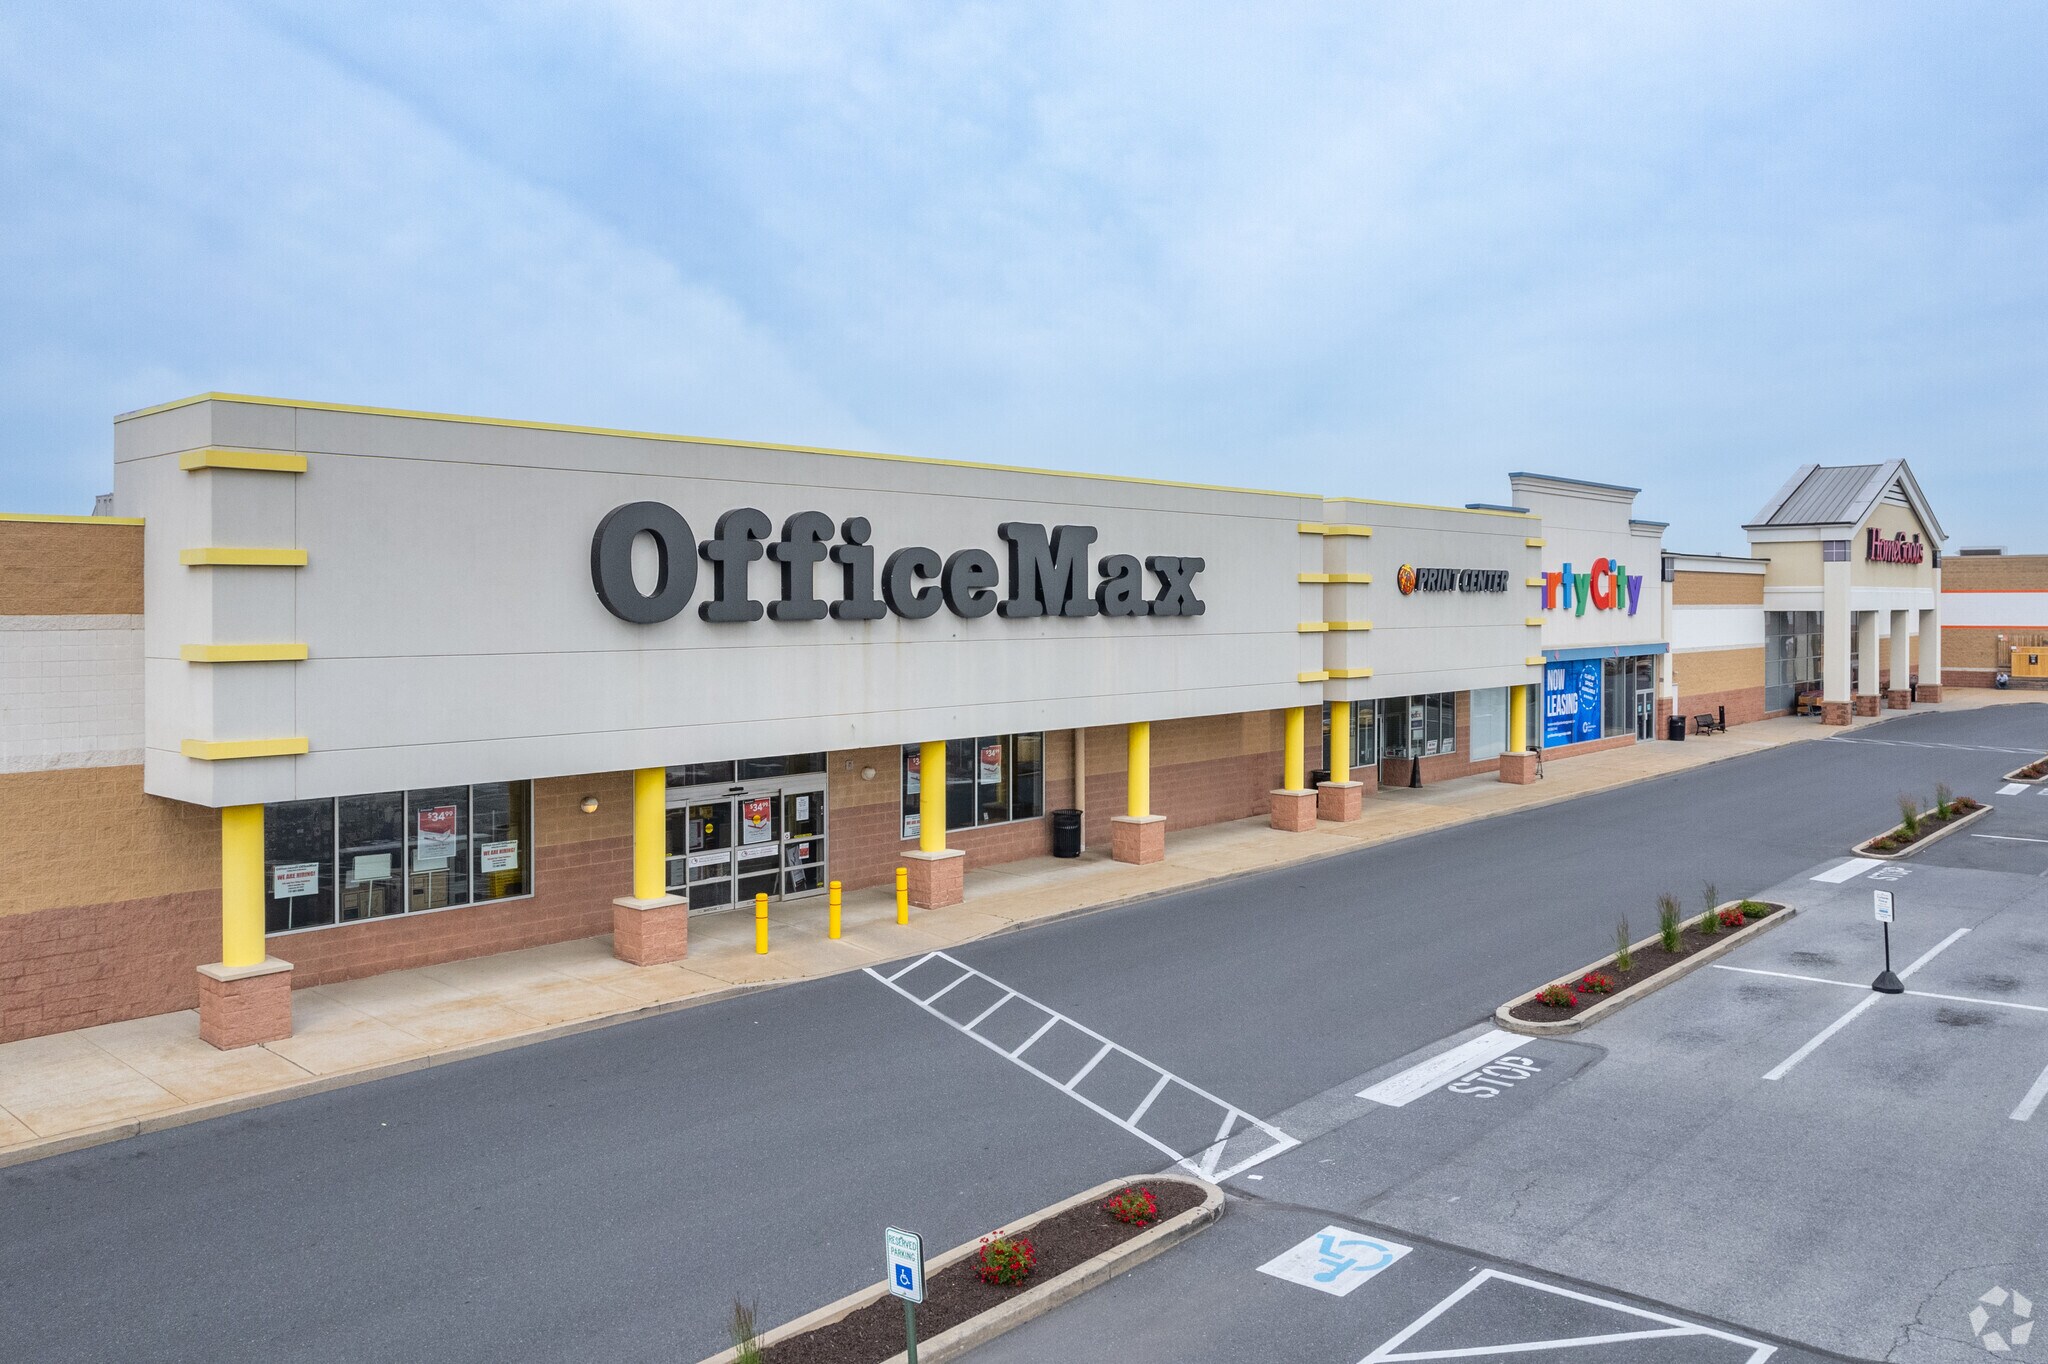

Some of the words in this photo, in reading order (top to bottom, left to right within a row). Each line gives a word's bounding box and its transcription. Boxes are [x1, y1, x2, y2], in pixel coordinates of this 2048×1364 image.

[1867, 528, 1923, 564] HomeGoods
[591, 501, 1206, 624] OfficeMax
[1414, 568, 1461, 592] PRINT
[1459, 569, 1509, 592] CENTER
[1542, 557, 1643, 617] rtyCity
[1547, 668, 1566, 691] NOW
[1547, 692, 1579, 717] LEASING
[1448, 1056, 1542, 1099] STOP
[888, 1234, 917, 1251] RESERVED
[890, 1247, 916, 1262] PARKING
